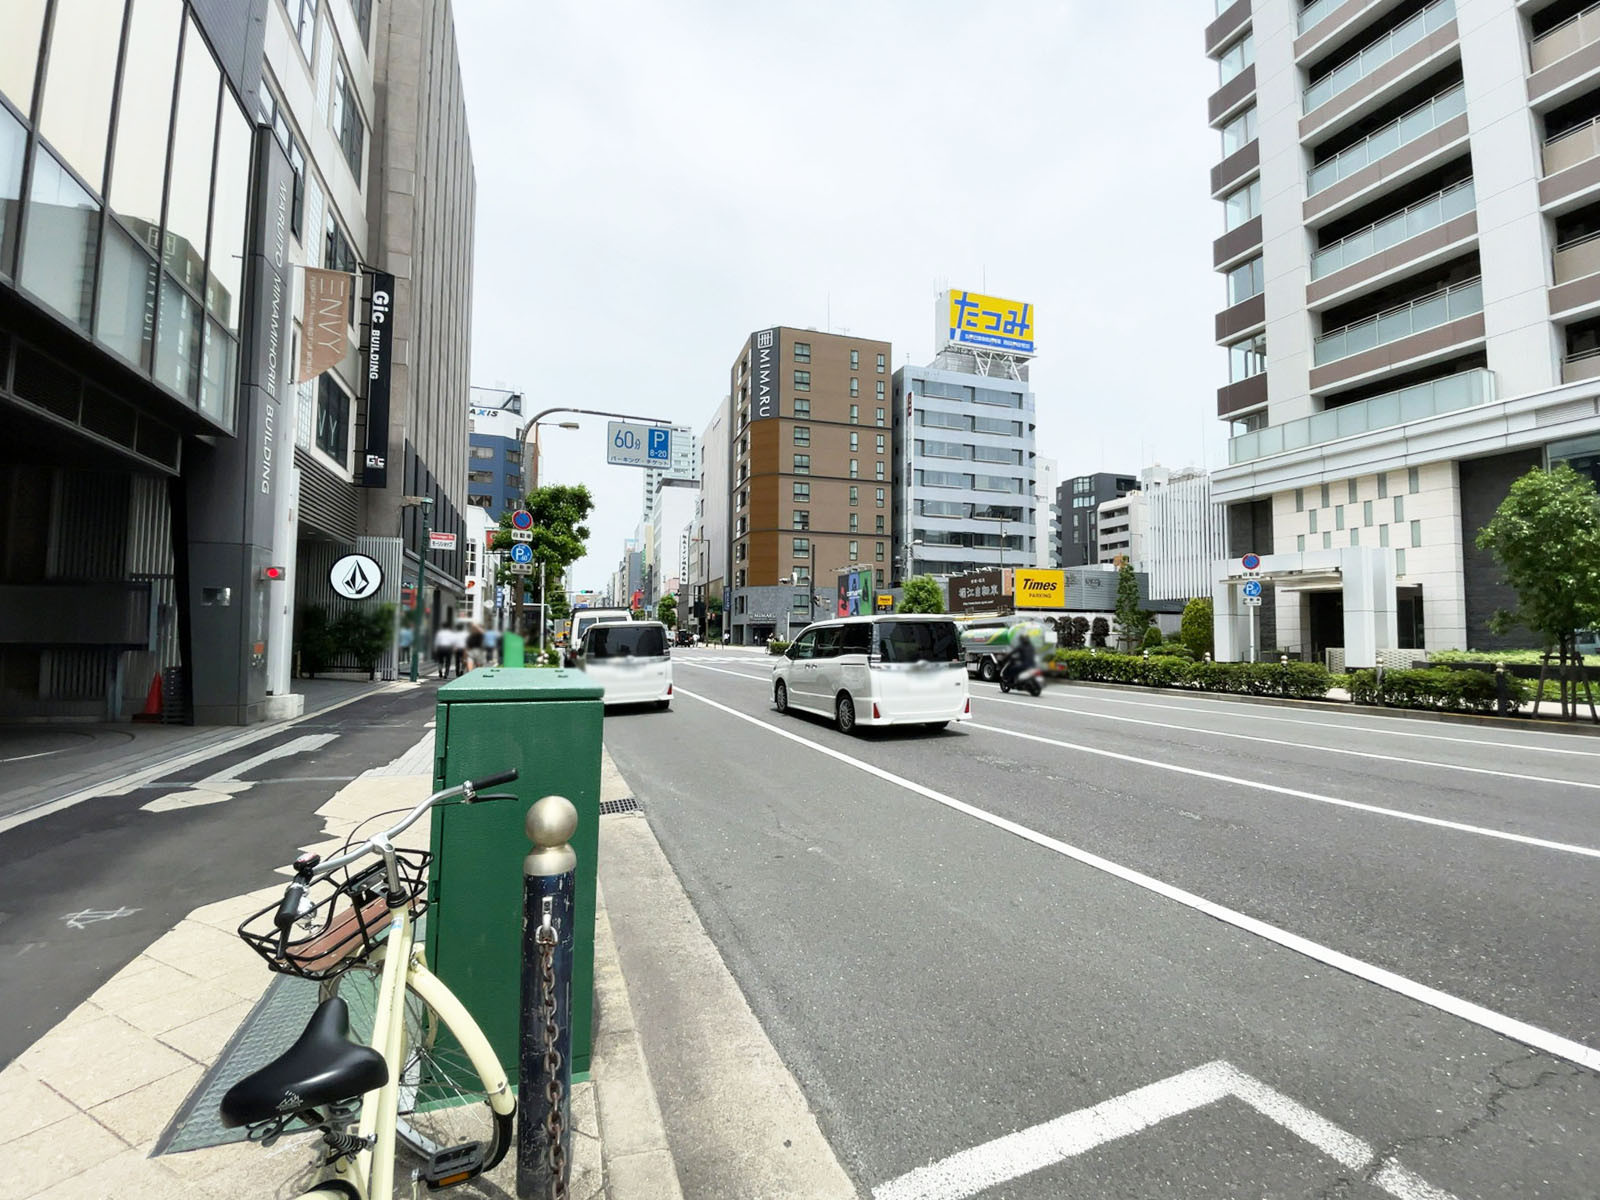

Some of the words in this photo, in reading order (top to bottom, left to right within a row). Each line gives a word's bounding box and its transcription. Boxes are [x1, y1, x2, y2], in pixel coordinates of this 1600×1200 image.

[274, 181, 288, 268] MARUITO
[317, 278, 344, 354] ENVY
[372, 290, 390, 323] Gic
[954, 292, 1030, 336] たつみ
[267, 273, 282, 396] MINAMIHORIE
[369, 329, 381, 380] BUILDING
[759, 349, 771, 417] MIMARU
[261, 404, 274, 495] BUILDING
[614, 429, 641, 450] 60分
[654, 431, 665, 448] P
[1023, 578, 1058, 591] Times
